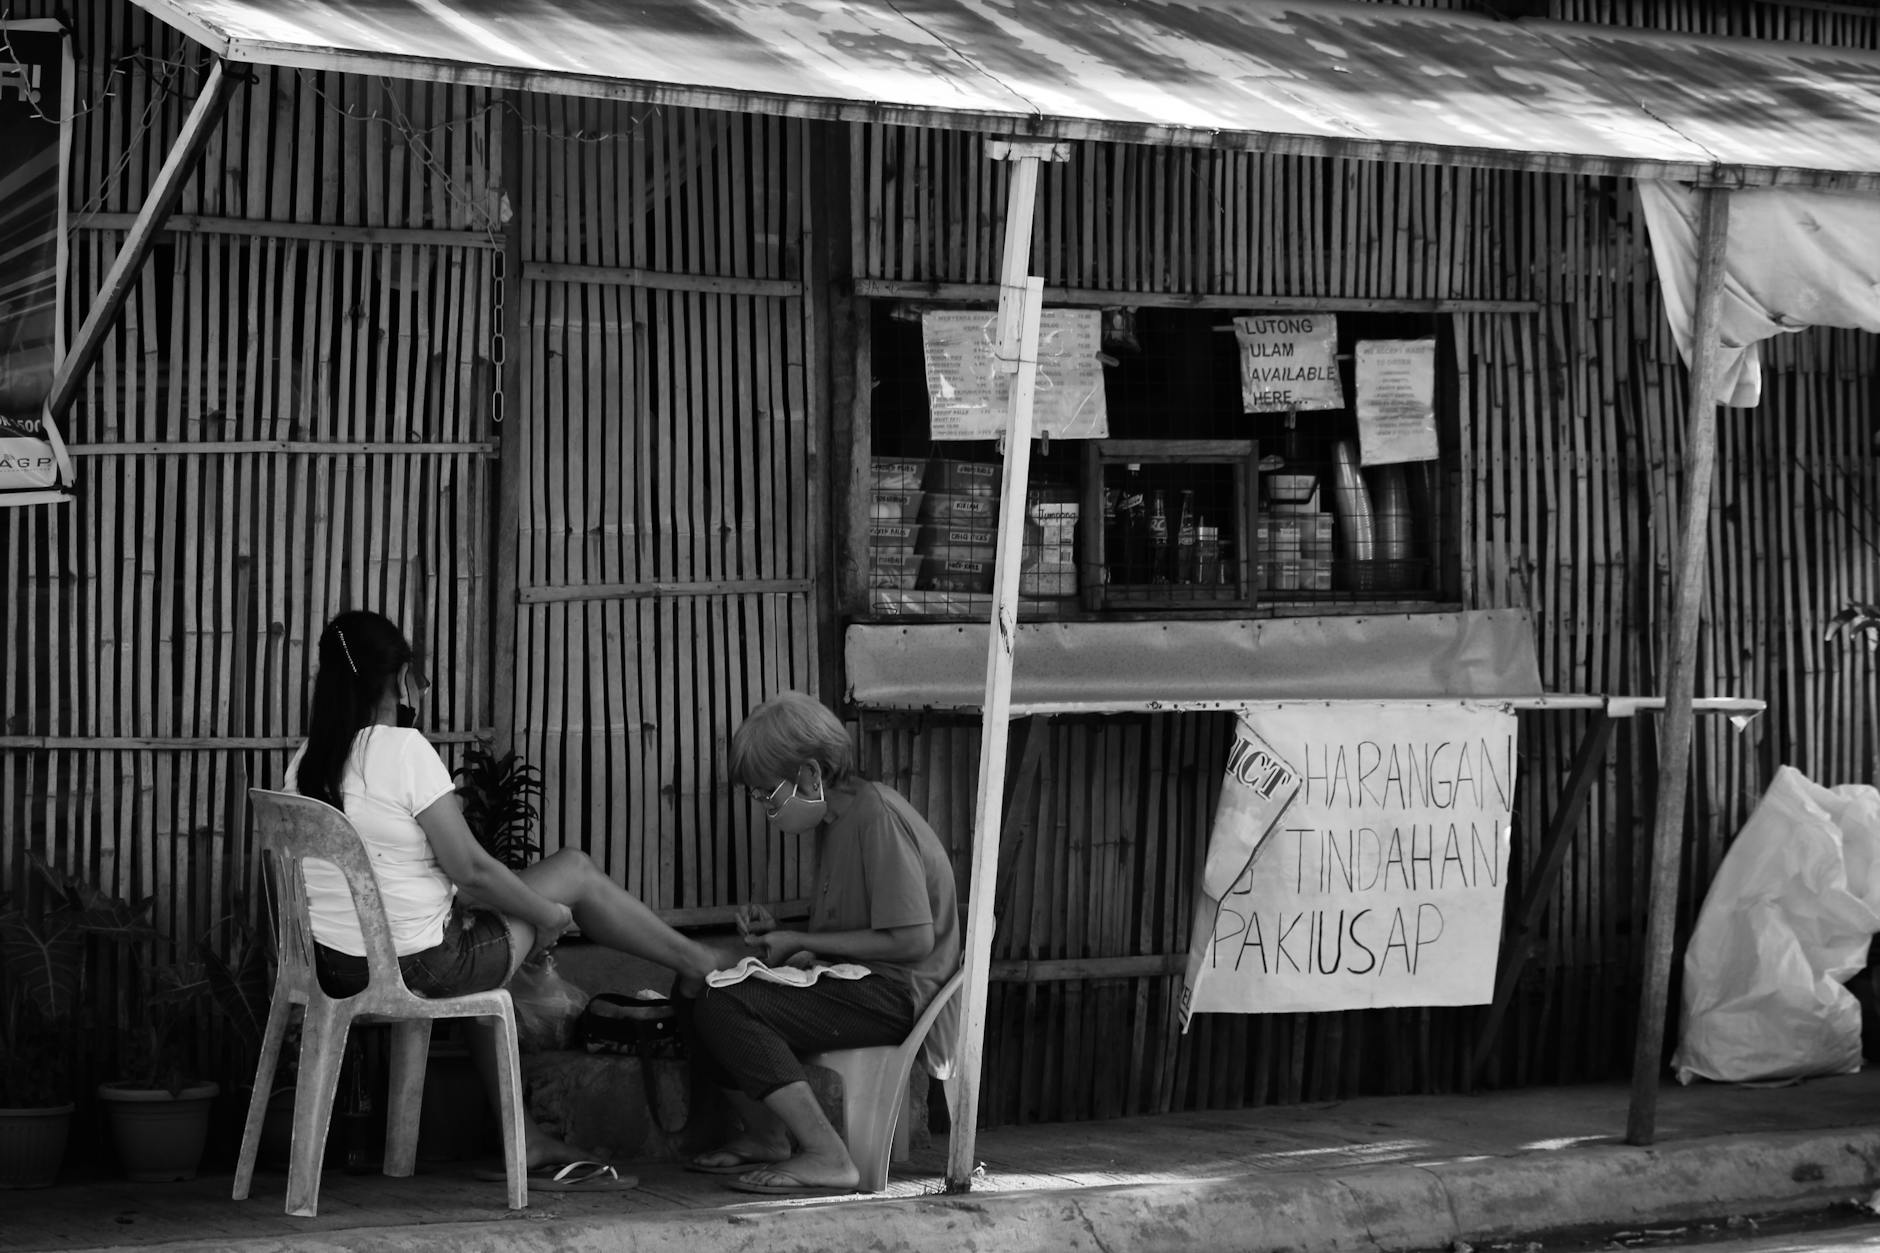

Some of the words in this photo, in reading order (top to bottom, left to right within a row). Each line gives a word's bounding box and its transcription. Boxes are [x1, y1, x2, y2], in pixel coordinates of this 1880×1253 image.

[1245, 318, 1313, 335] LUTONG
[1250, 343, 1294, 358] ULAM
[1251, 366, 1336, 382] AVAILABLE
[1225, 733, 1293, 802] ICT
[1304, 734, 1513, 813] HARANGAN
[1285, 819, 1499, 895] TINDAHAN
[1212, 902, 1444, 977] PAKIUSAP
